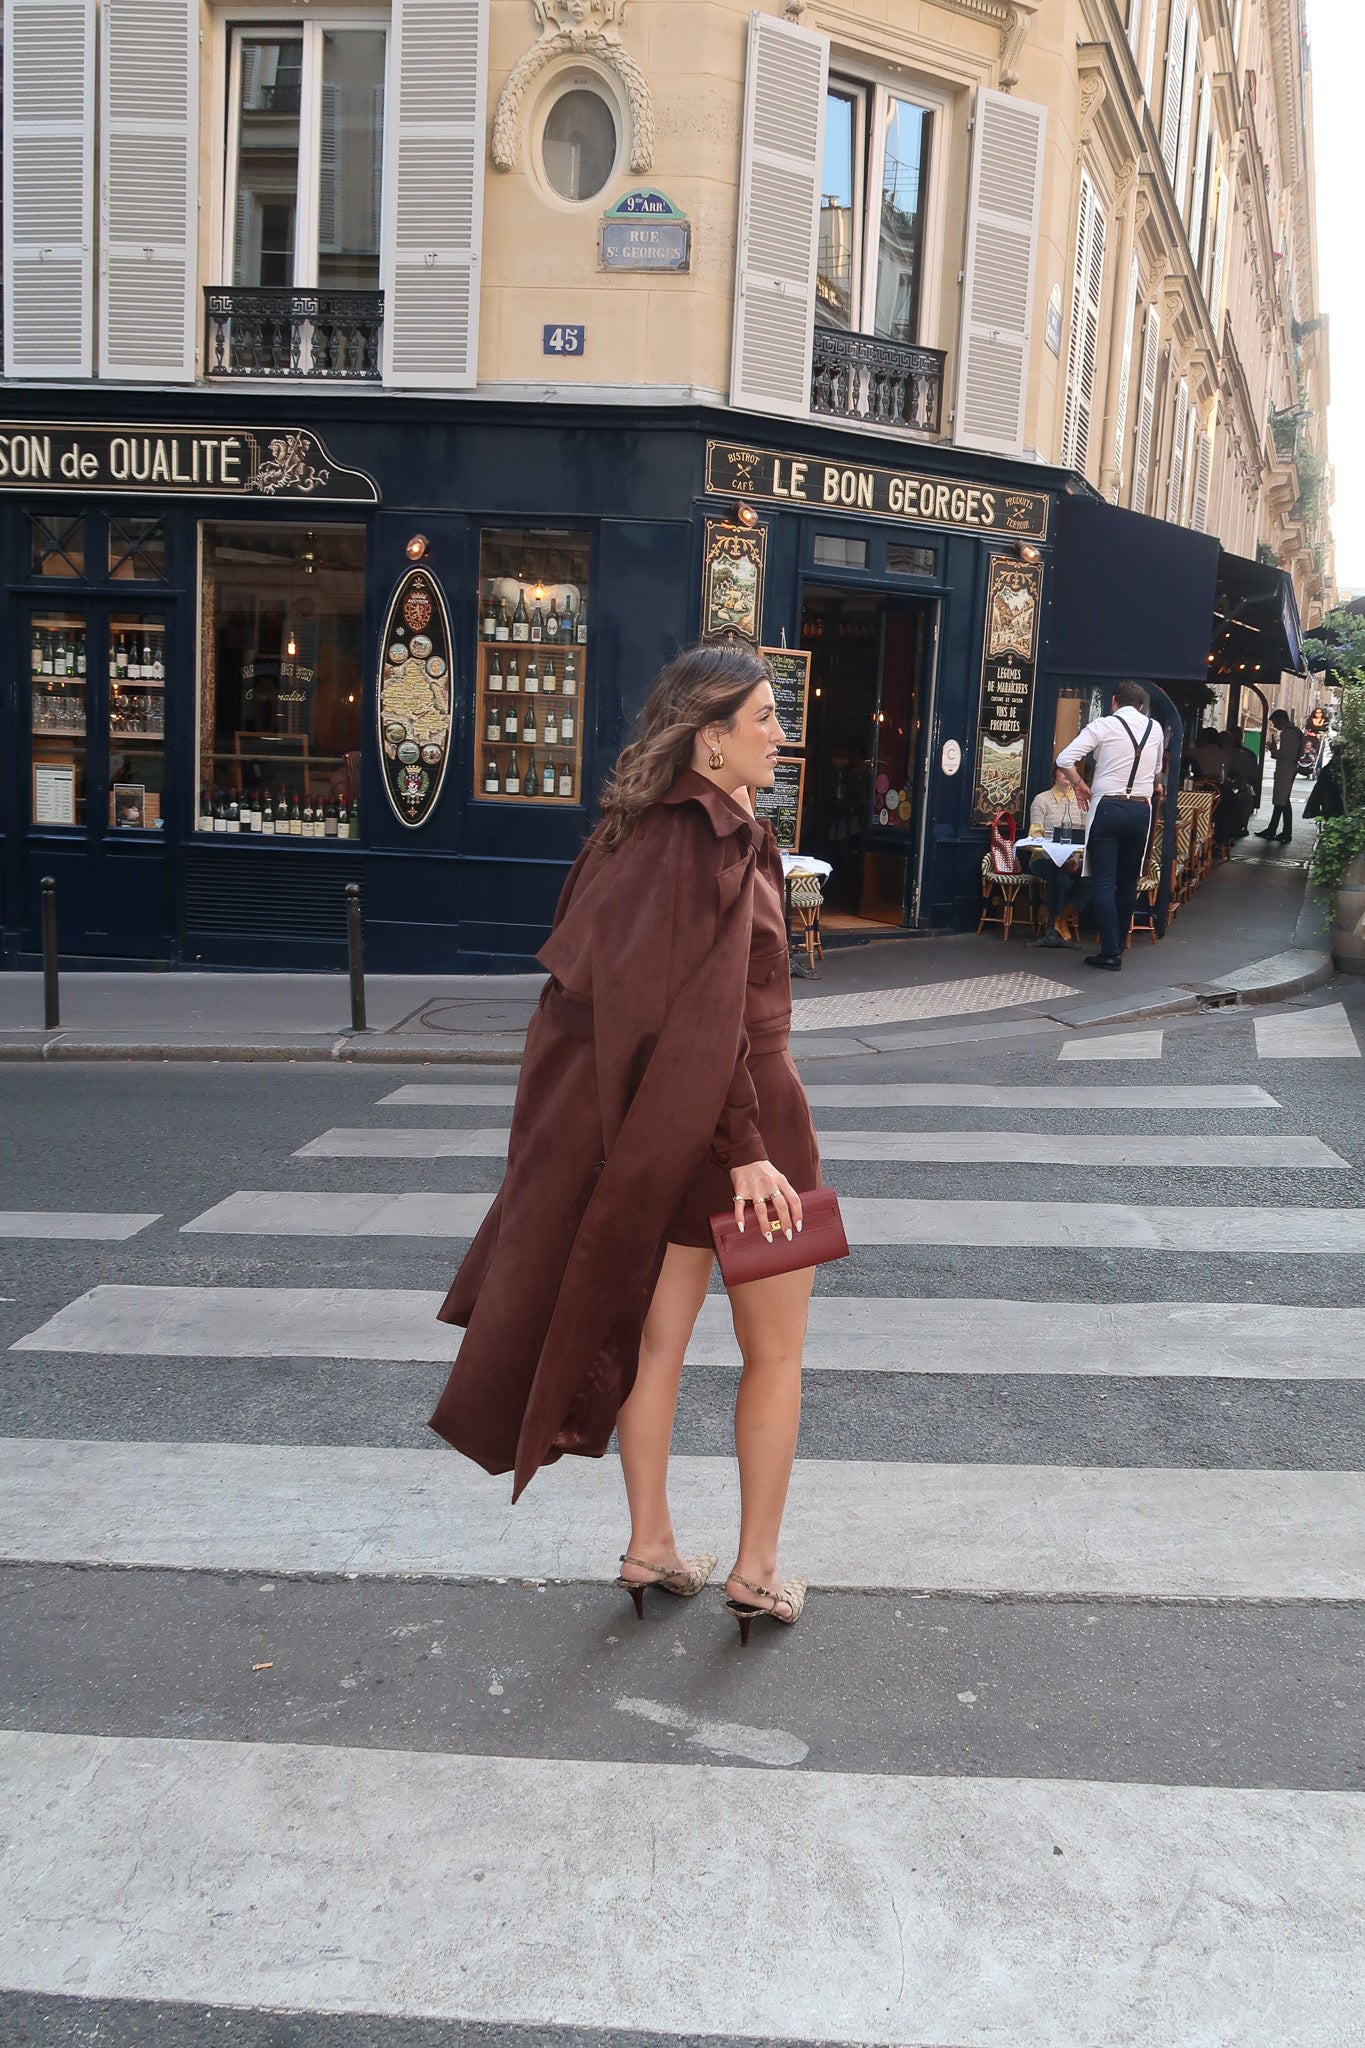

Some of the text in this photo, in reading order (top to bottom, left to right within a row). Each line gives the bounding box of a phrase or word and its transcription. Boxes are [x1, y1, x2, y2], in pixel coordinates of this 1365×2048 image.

[629, 230, 660, 243] RUE
[621, 246, 681, 259] GEORGES
[549, 328, 578, 351] 45
[60, 442, 99, 479] de
[109, 436, 241, 484] QUALITÉ
[727, 452, 760, 466] BISTROT
[731, 479, 754, 491] CAFÉ
[772, 459, 996, 526] LE BON GEORGES
[1005, 496, 1034, 510] PRODUITS
[987, 680, 995, 692] DE
[996, 705, 1017, 719] VINS DE
[990, 719, 1020, 732] PROPRIÉTÉS
